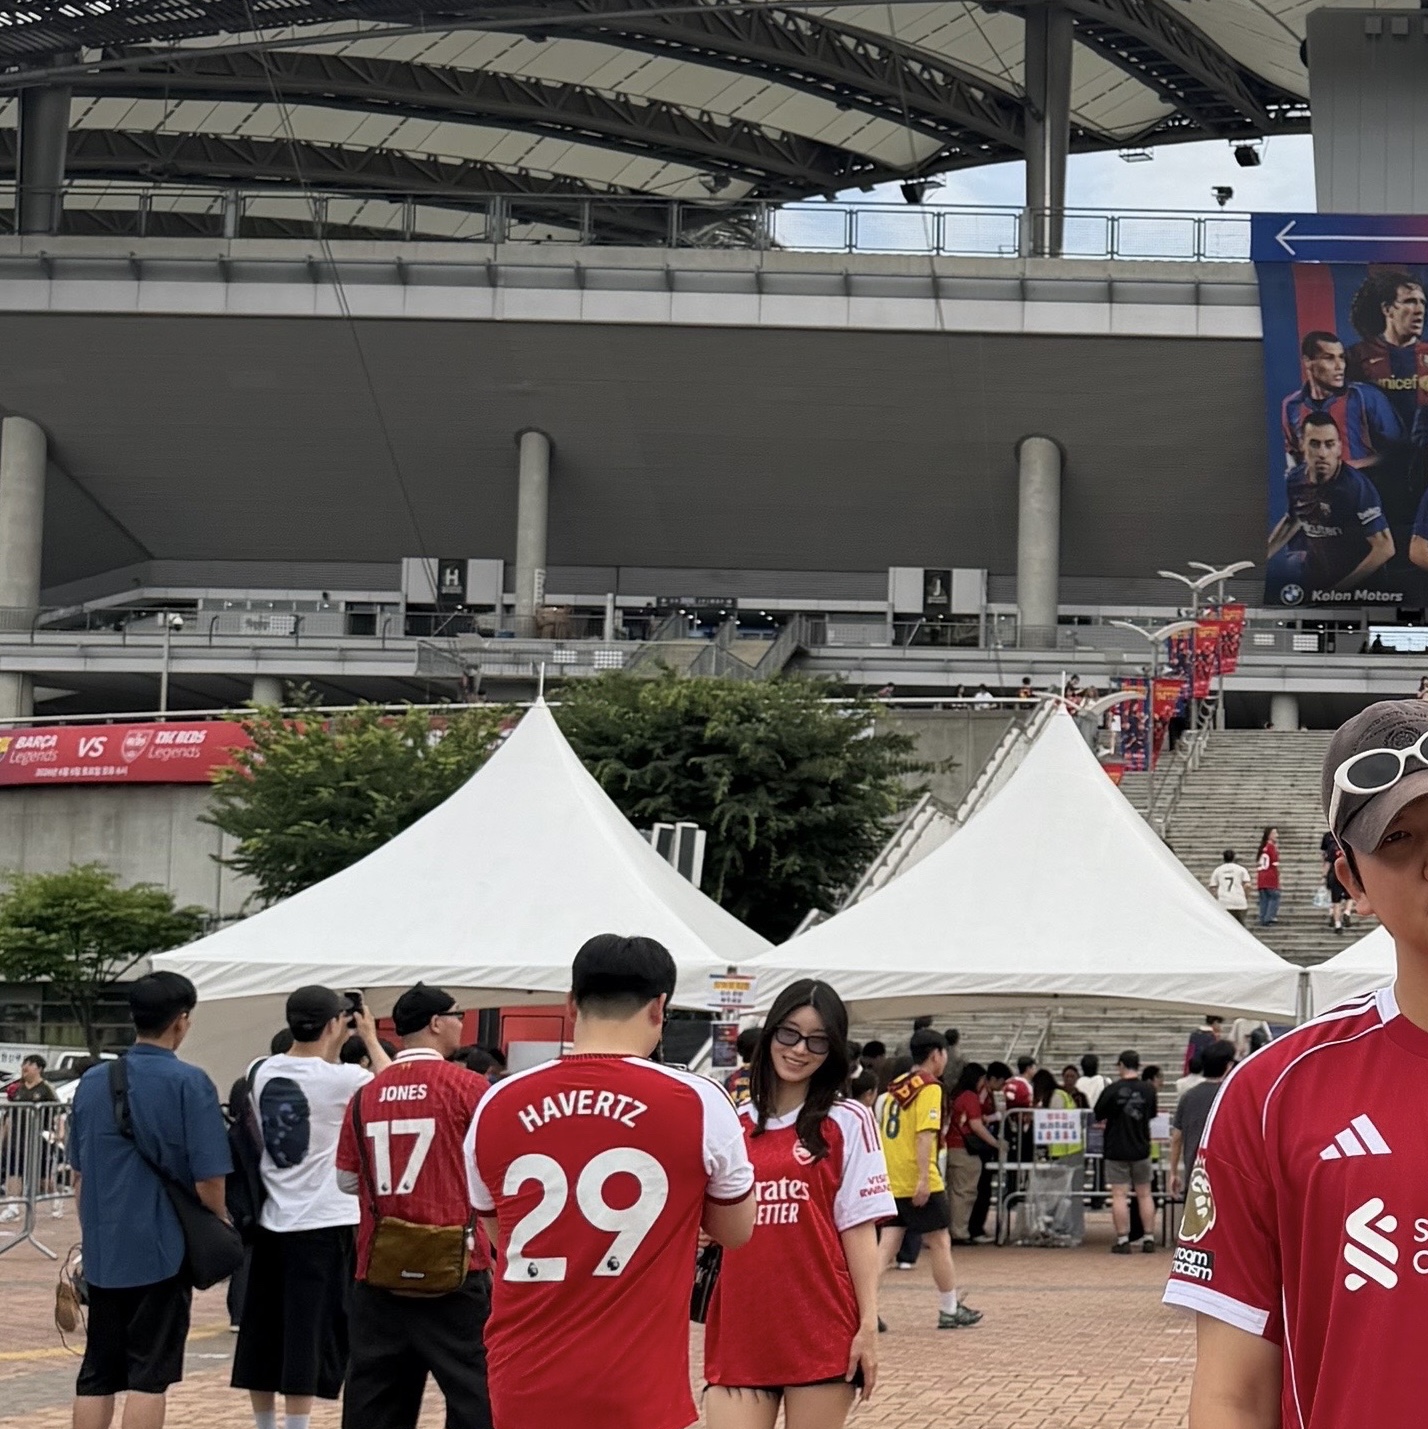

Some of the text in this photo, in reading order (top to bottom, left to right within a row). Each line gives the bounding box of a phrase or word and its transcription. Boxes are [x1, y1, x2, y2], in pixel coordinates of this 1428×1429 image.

[445, 568, 459, 586] H
[1354, 589, 1403, 602] Motors
[78, 736, 109, 758] VS
[148, 744, 201, 762] Legends
[1225, 876, 1234, 892] 7
[378, 1083, 428, 1103] JONES
[517, 1089, 648, 1133] HAVERTZ
[366, 1118, 436, 1196] 17
[755, 1176, 809, 1202] rates
[502, 1146, 669, 1282] 29
[756, 1202, 799, 1226] ETTER
